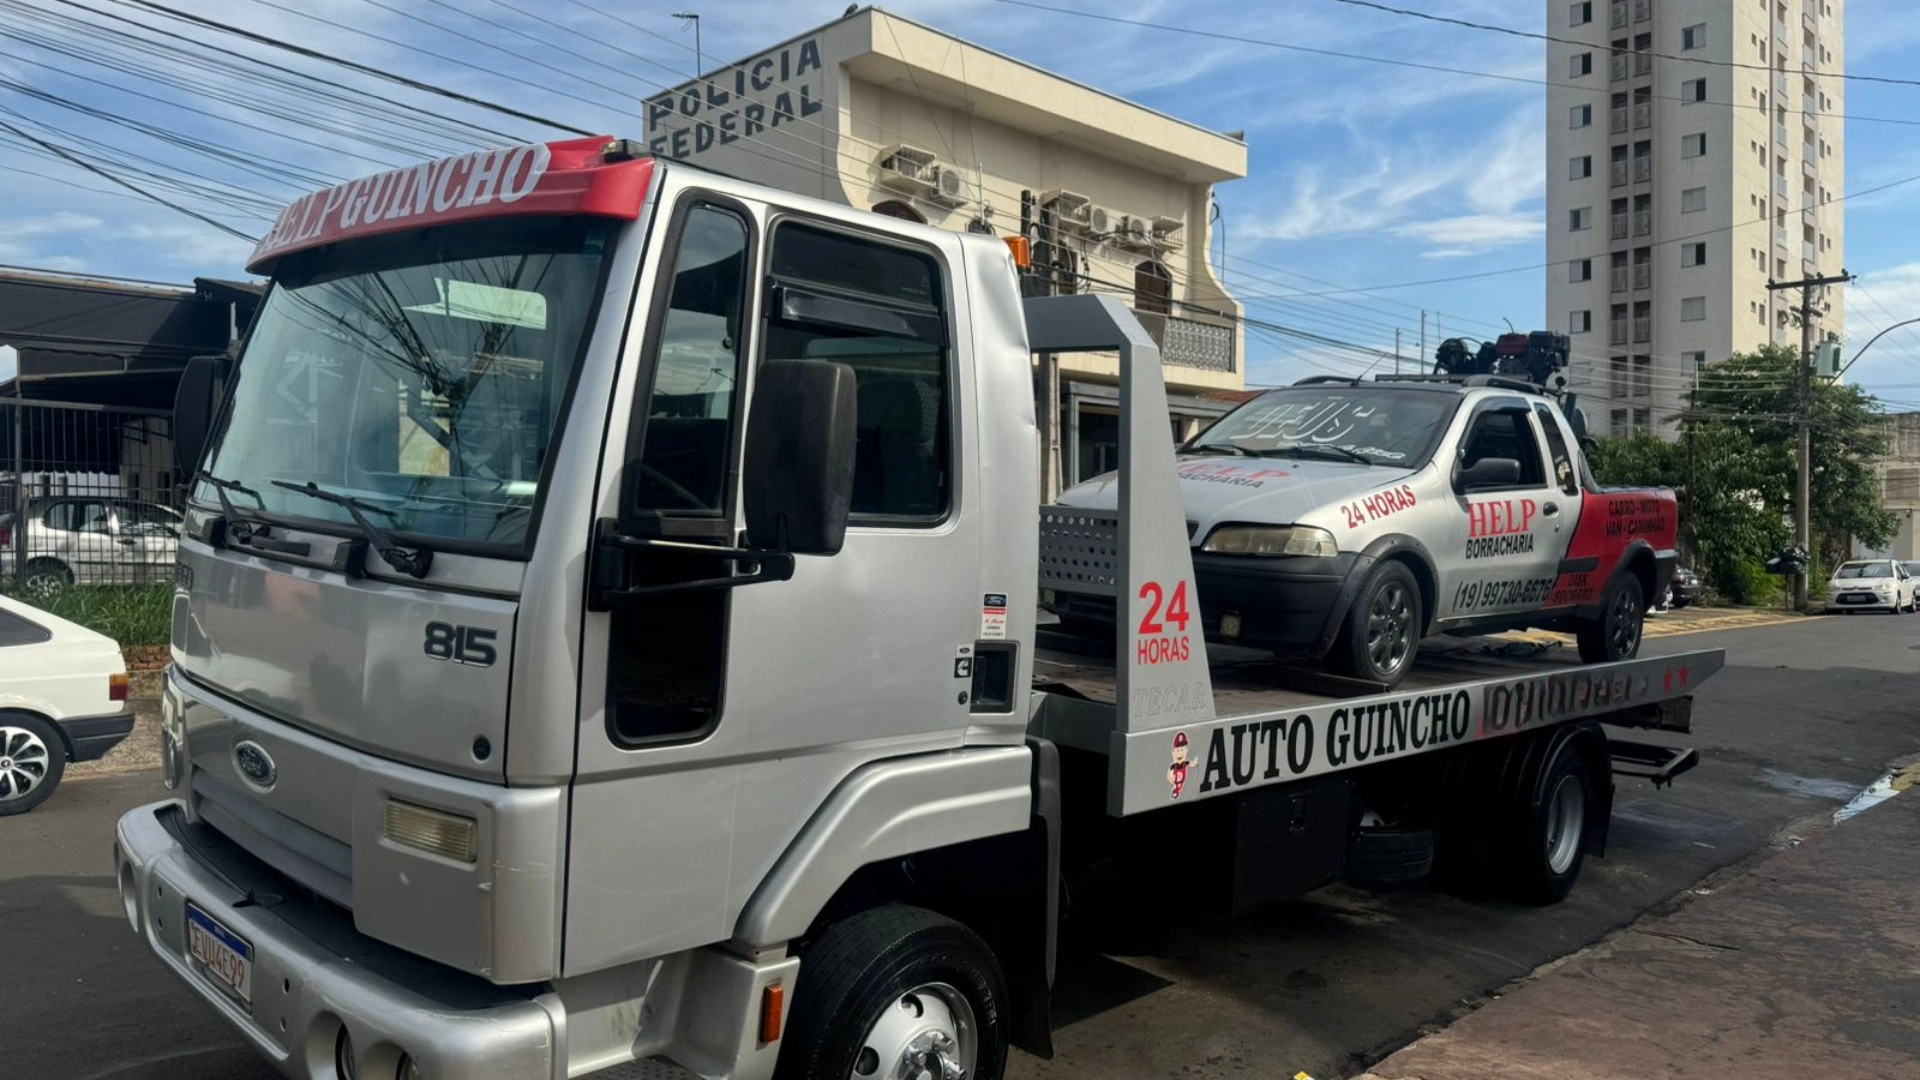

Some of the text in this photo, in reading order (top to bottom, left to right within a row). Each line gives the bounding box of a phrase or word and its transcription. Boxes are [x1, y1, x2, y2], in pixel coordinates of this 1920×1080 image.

[650, 39, 822, 132] POLICIA
[650, 85, 823, 158] FEDERAL
[1341, 485, 1417, 529] 24 HORAS
[1468, 498, 1537, 537] HELP
[1465, 533, 1534, 559] BORRACHARIA
[1138, 580, 1189, 635] 24
[423, 620, 498, 667] 815
[1137, 636, 1189, 665] HORAS
[1200, 714, 1314, 793] AUTO
[1326, 690, 1470, 767] GUINCHO
